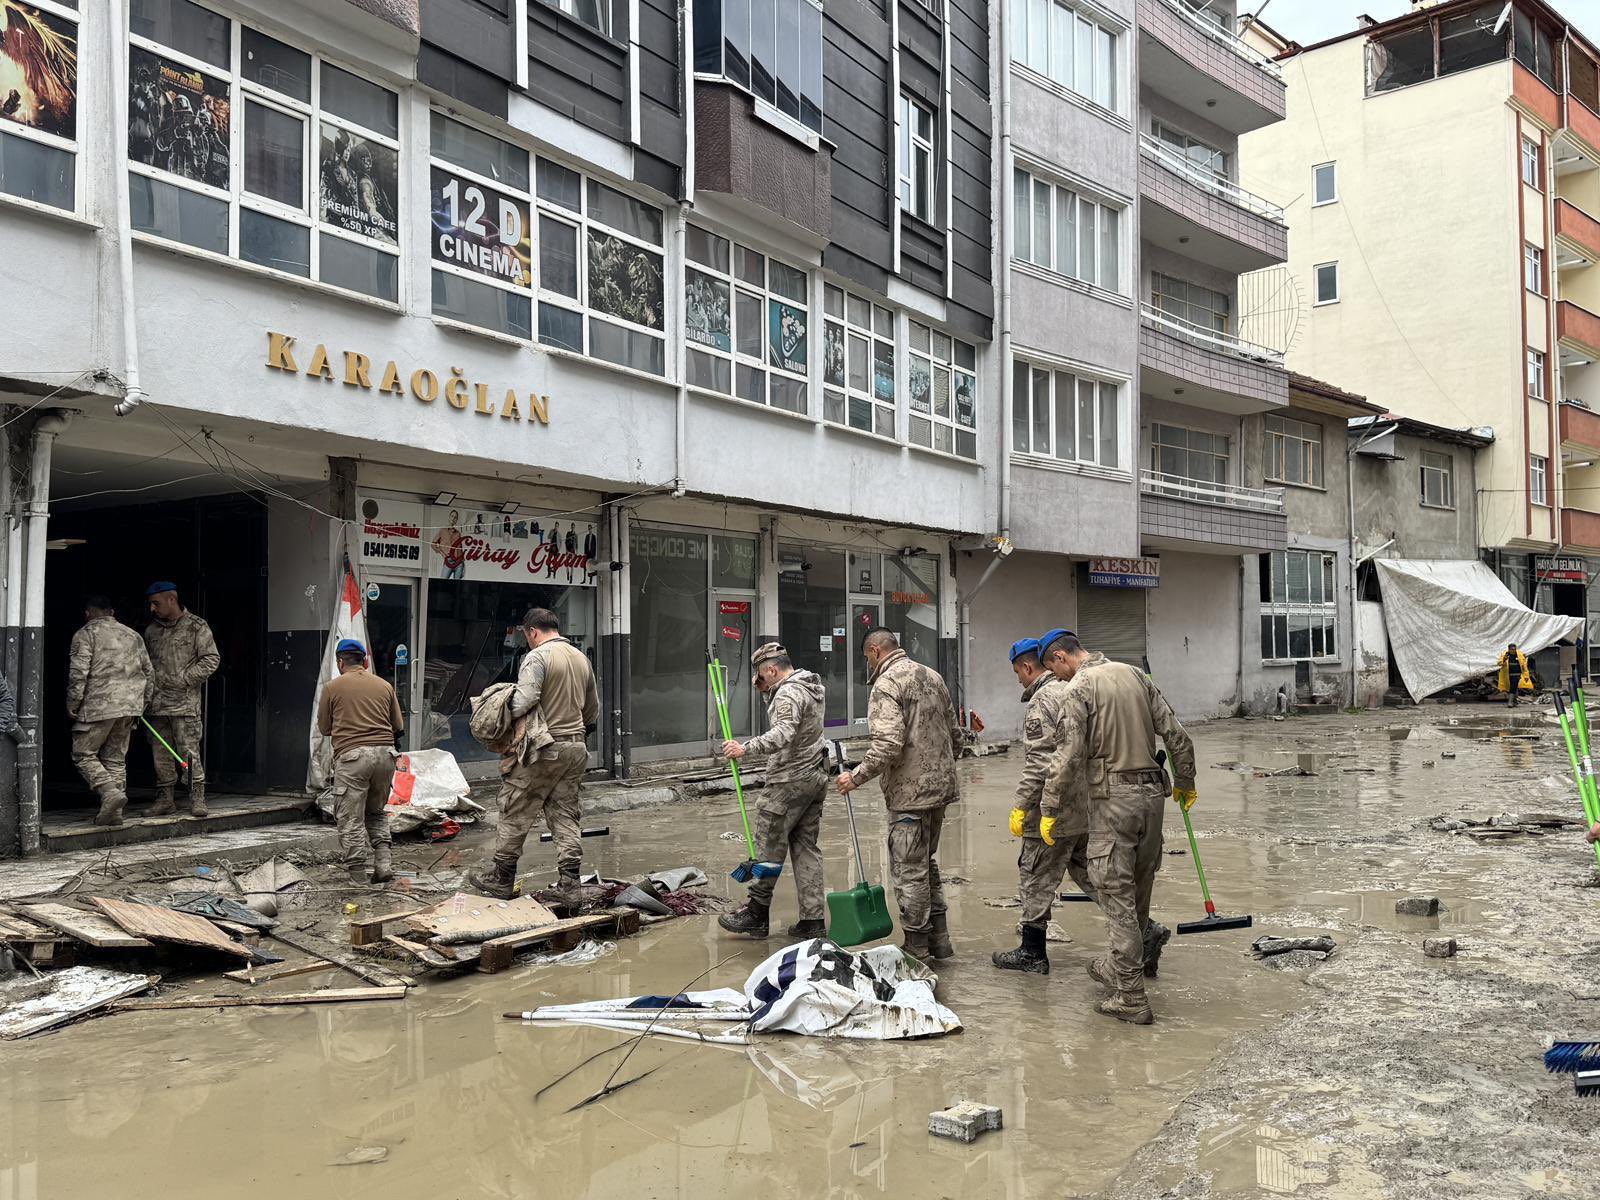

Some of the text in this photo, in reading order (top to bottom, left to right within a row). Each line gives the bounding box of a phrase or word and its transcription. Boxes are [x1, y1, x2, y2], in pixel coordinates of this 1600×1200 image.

[321, 198, 397, 232] PREMİUM CAFE
[340, 217, 377, 236] %50 XP
[442, 179, 521, 246] 12 D
[440, 234, 524, 280] CINEMA
[265, 331, 550, 424] KARAOĞLAN
[363, 541, 370, 556] 0
[445, 535, 520, 569] Güray
[1092, 558, 1158, 575] KESKİN
